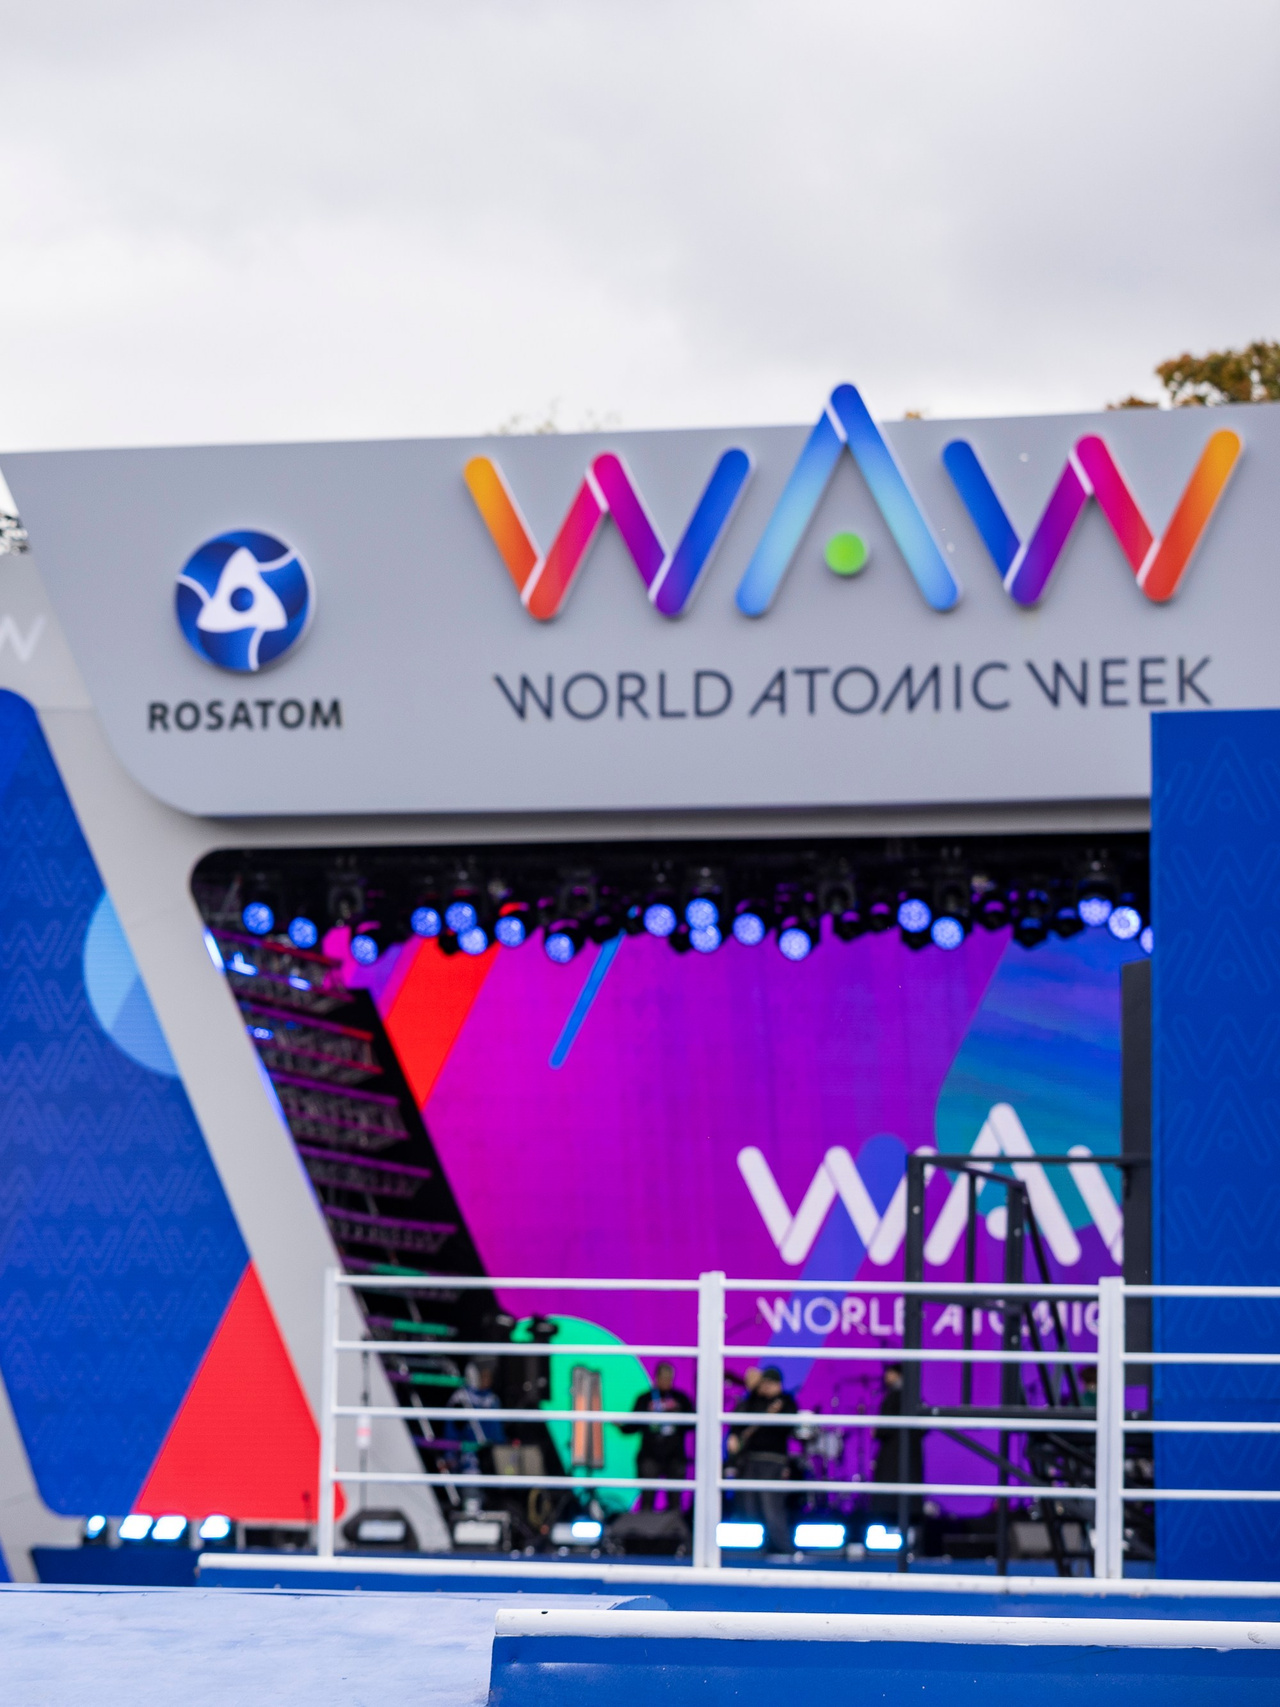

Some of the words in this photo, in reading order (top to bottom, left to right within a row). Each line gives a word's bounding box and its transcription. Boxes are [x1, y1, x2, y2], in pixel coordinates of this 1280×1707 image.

[463, 383, 1242, 622] WAW
[148, 698, 343, 731] ROSATOM
[493, 669, 734, 721] WORLD
[748, 660, 1012, 718] ATOMIC
[1024, 655, 1213, 709] WEEK
